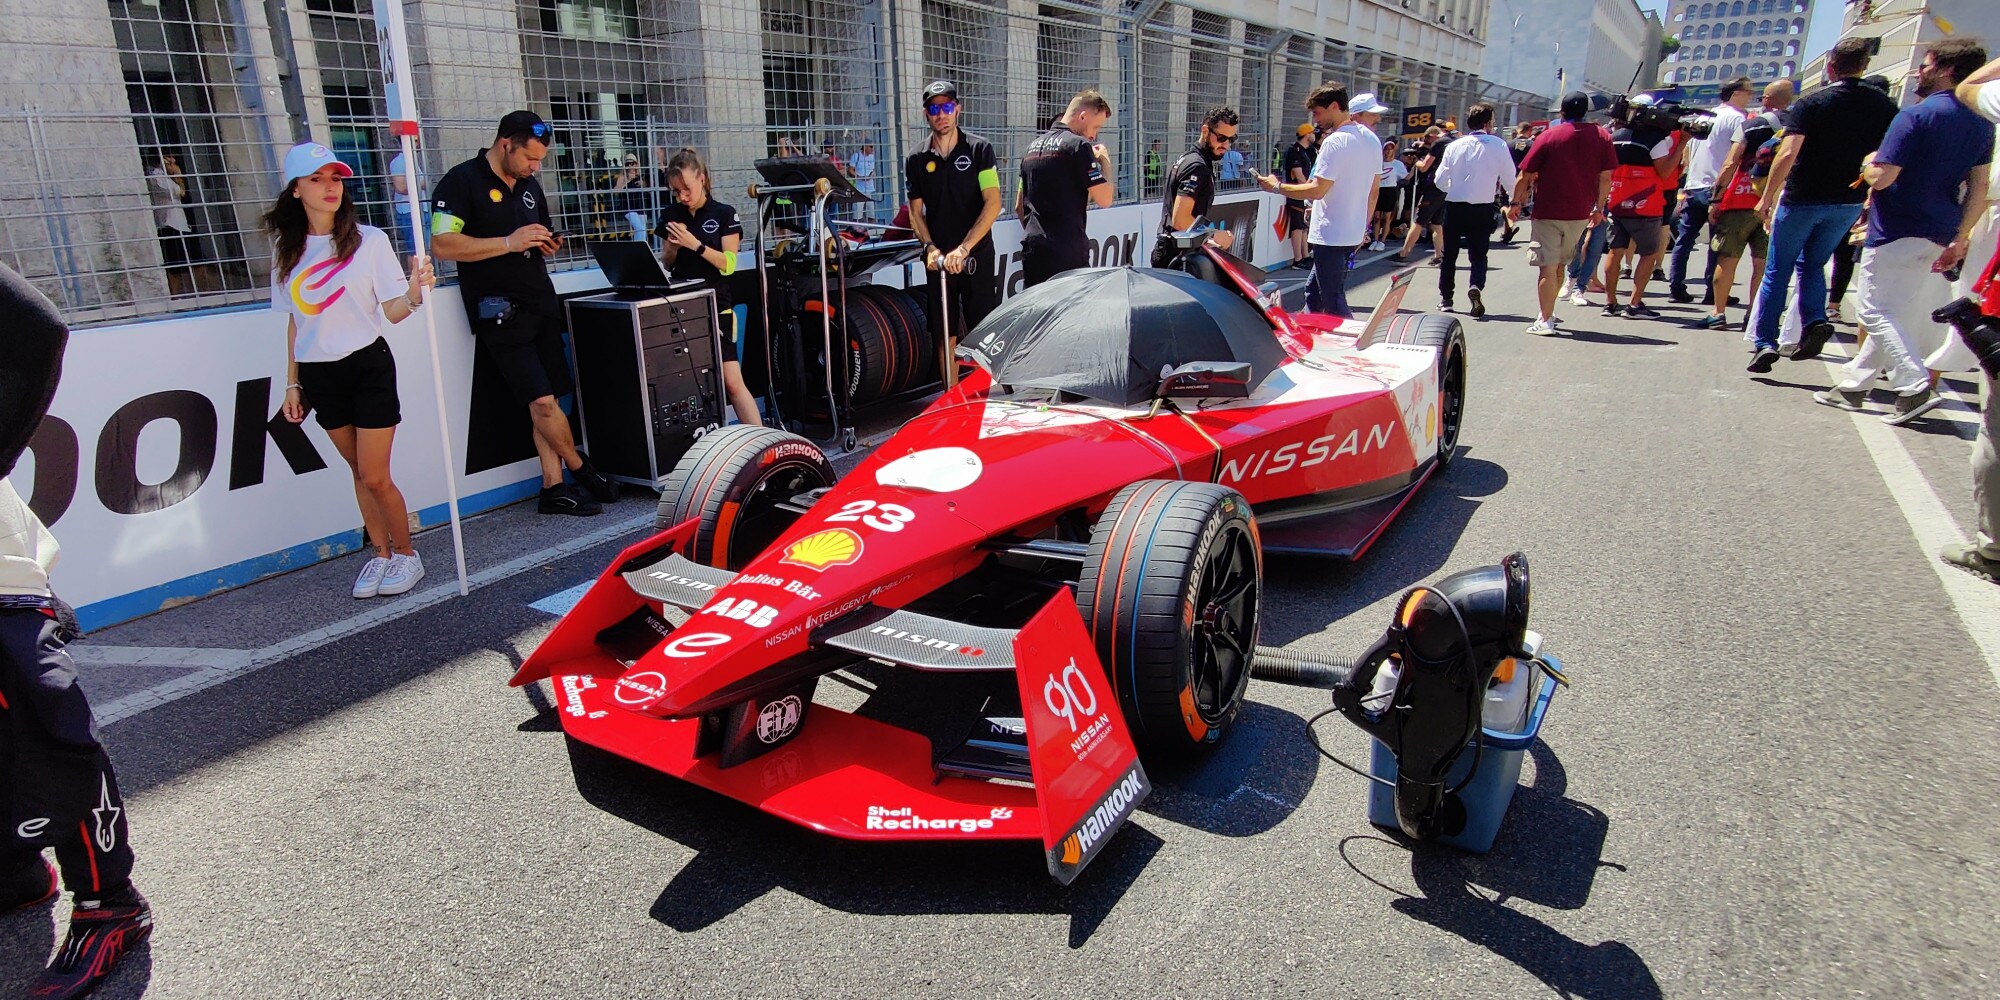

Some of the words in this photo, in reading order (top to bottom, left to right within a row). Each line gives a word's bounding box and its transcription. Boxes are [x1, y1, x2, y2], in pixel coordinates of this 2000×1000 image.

[1407, 112, 1432, 127] 58
[1734, 184, 1756, 194] 91
[993, 232, 1139, 304] HaOK
[1217, 420, 1396, 484] NISSAN
[824, 499, 915, 532] 23
[732, 573, 785, 587] Julius
[783, 579, 823, 601] Bär
[701, 597, 780, 628] ABB
[765, 623, 803, 649] NISSAN
[805, 594, 868, 630] INTELLIGENT
[868, 573, 914, 599] MOBILITY
[644, 616, 672, 638] NISSA
[561, 675, 586, 717] Recharge
[617, 678, 665, 698] NISSAN
[1070, 712, 1110, 754] NISSAN
[866, 815, 994, 833] Recharge
[867, 805, 912, 817] Shell
